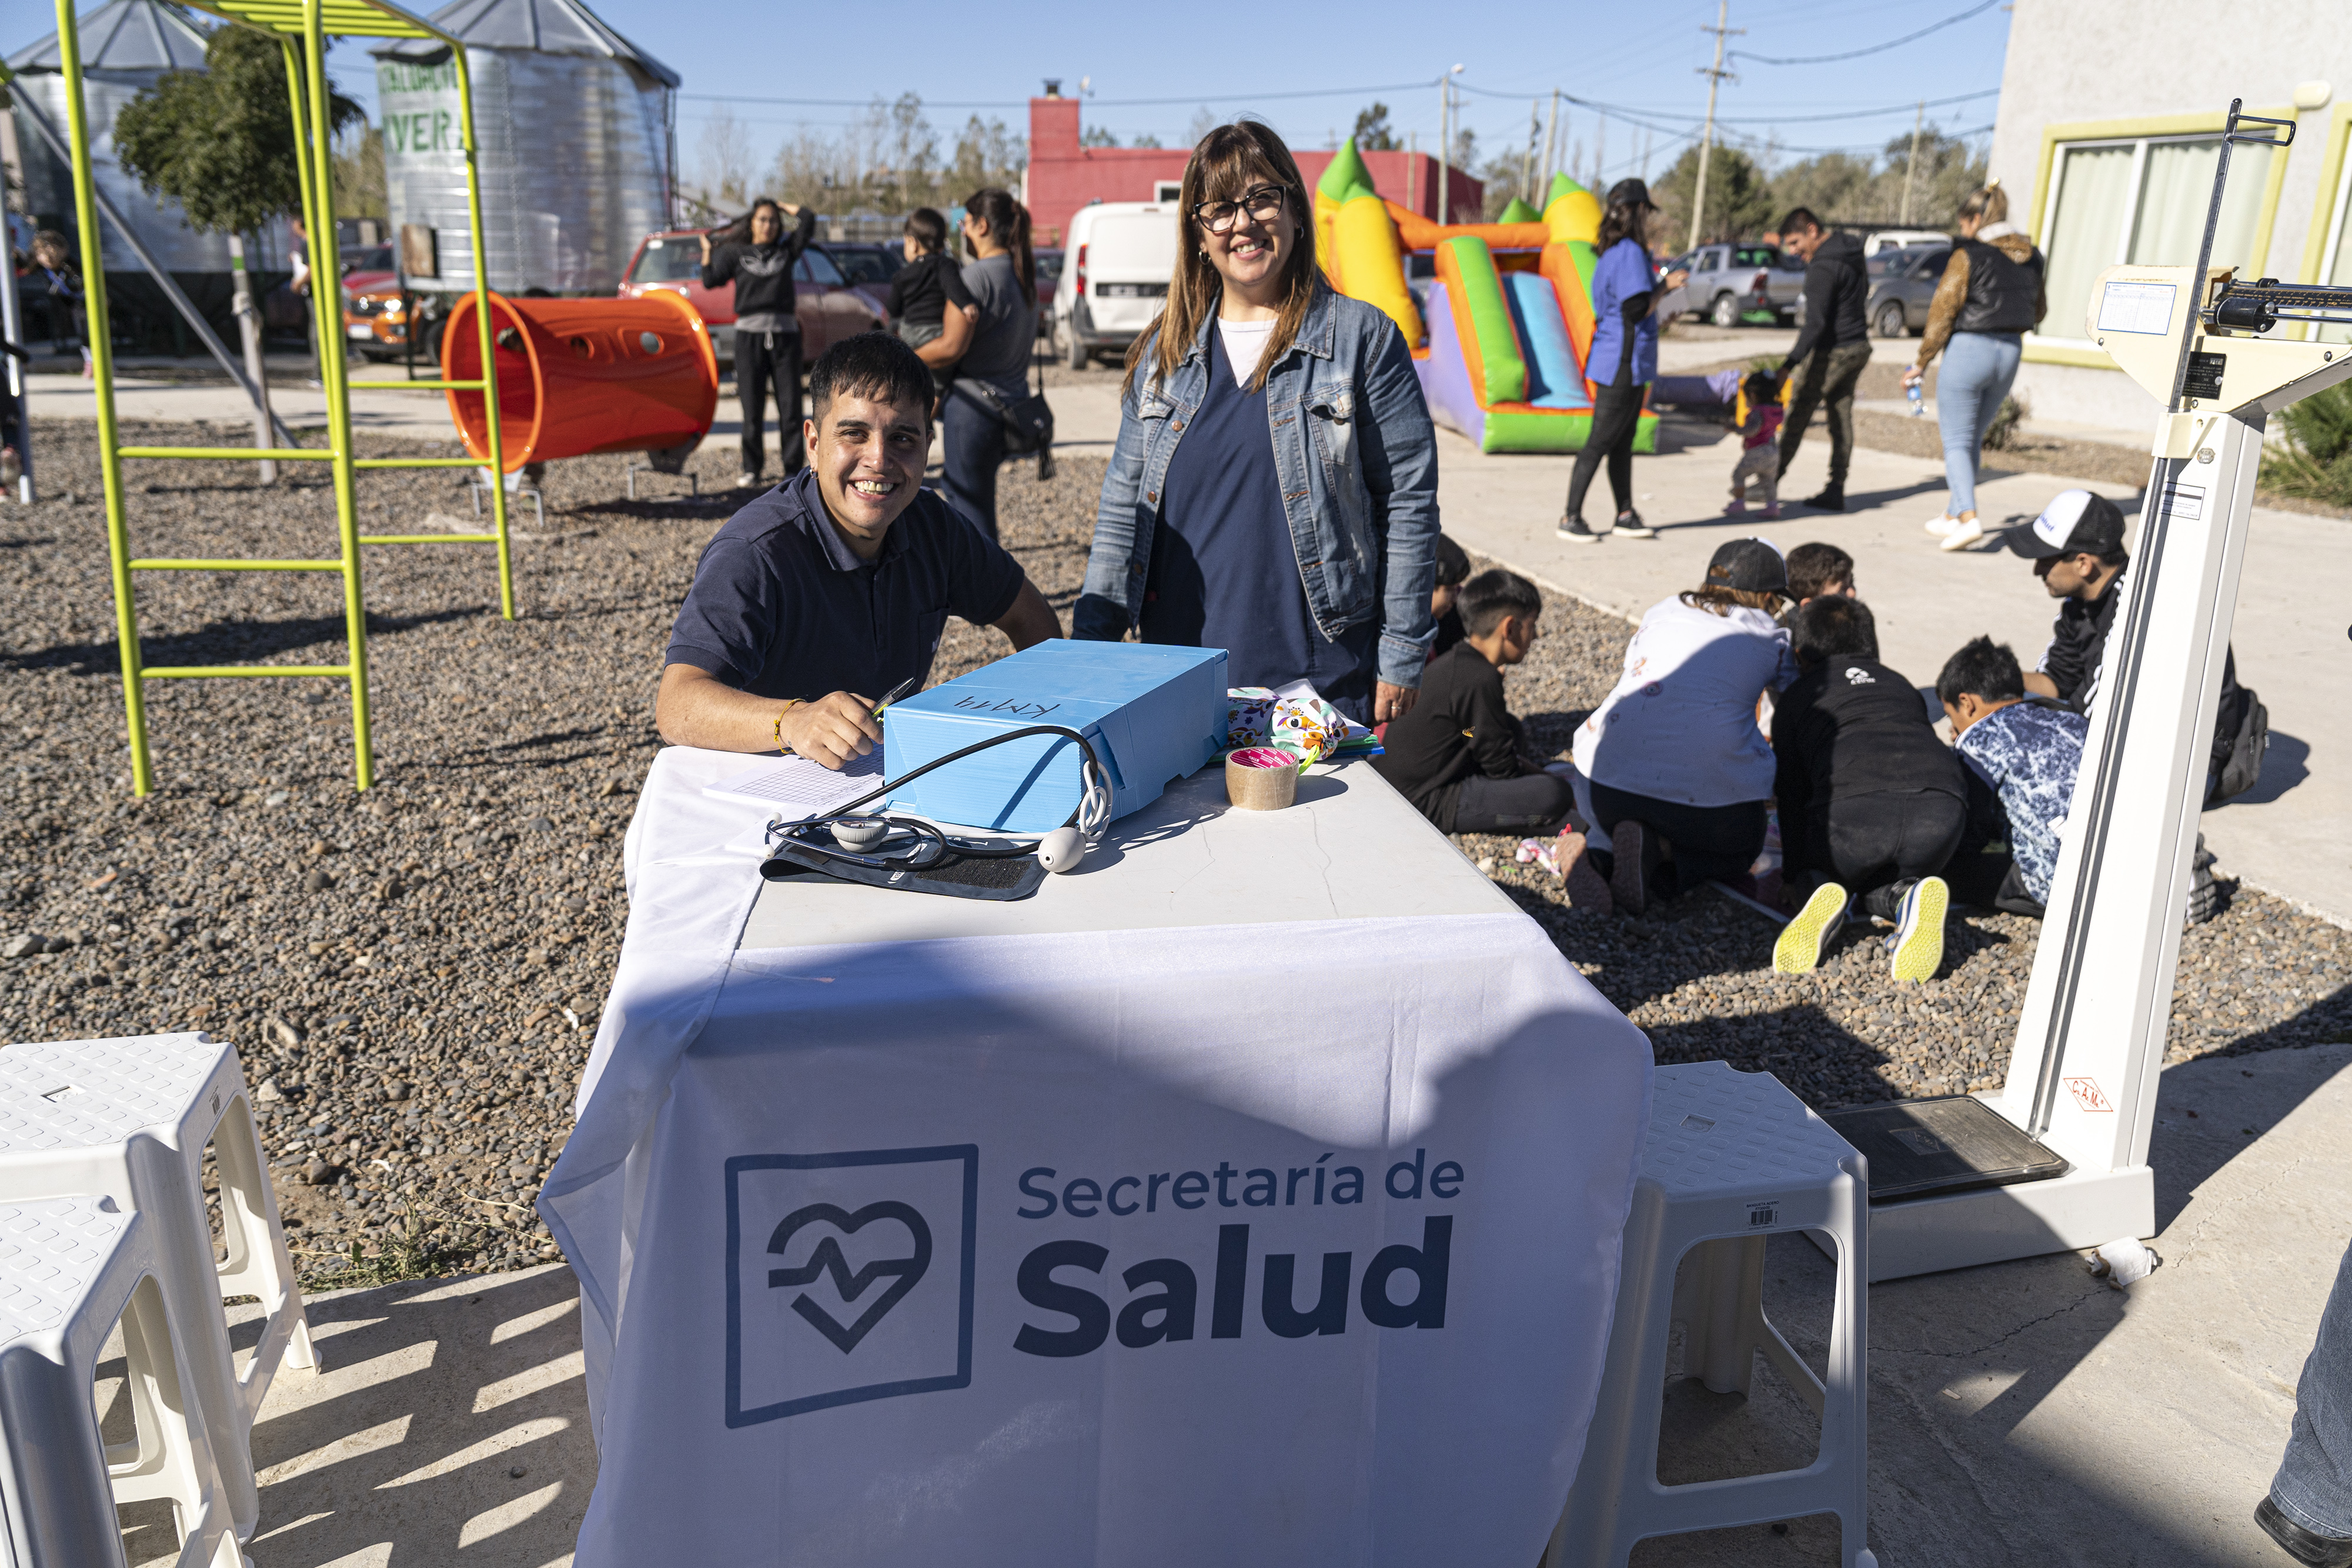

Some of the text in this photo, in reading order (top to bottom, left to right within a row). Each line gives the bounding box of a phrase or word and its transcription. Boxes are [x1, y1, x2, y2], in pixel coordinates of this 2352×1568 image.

[1017, 1148, 1465, 1219] Secretaría de
[1013, 1215, 1454, 1358] Salud
